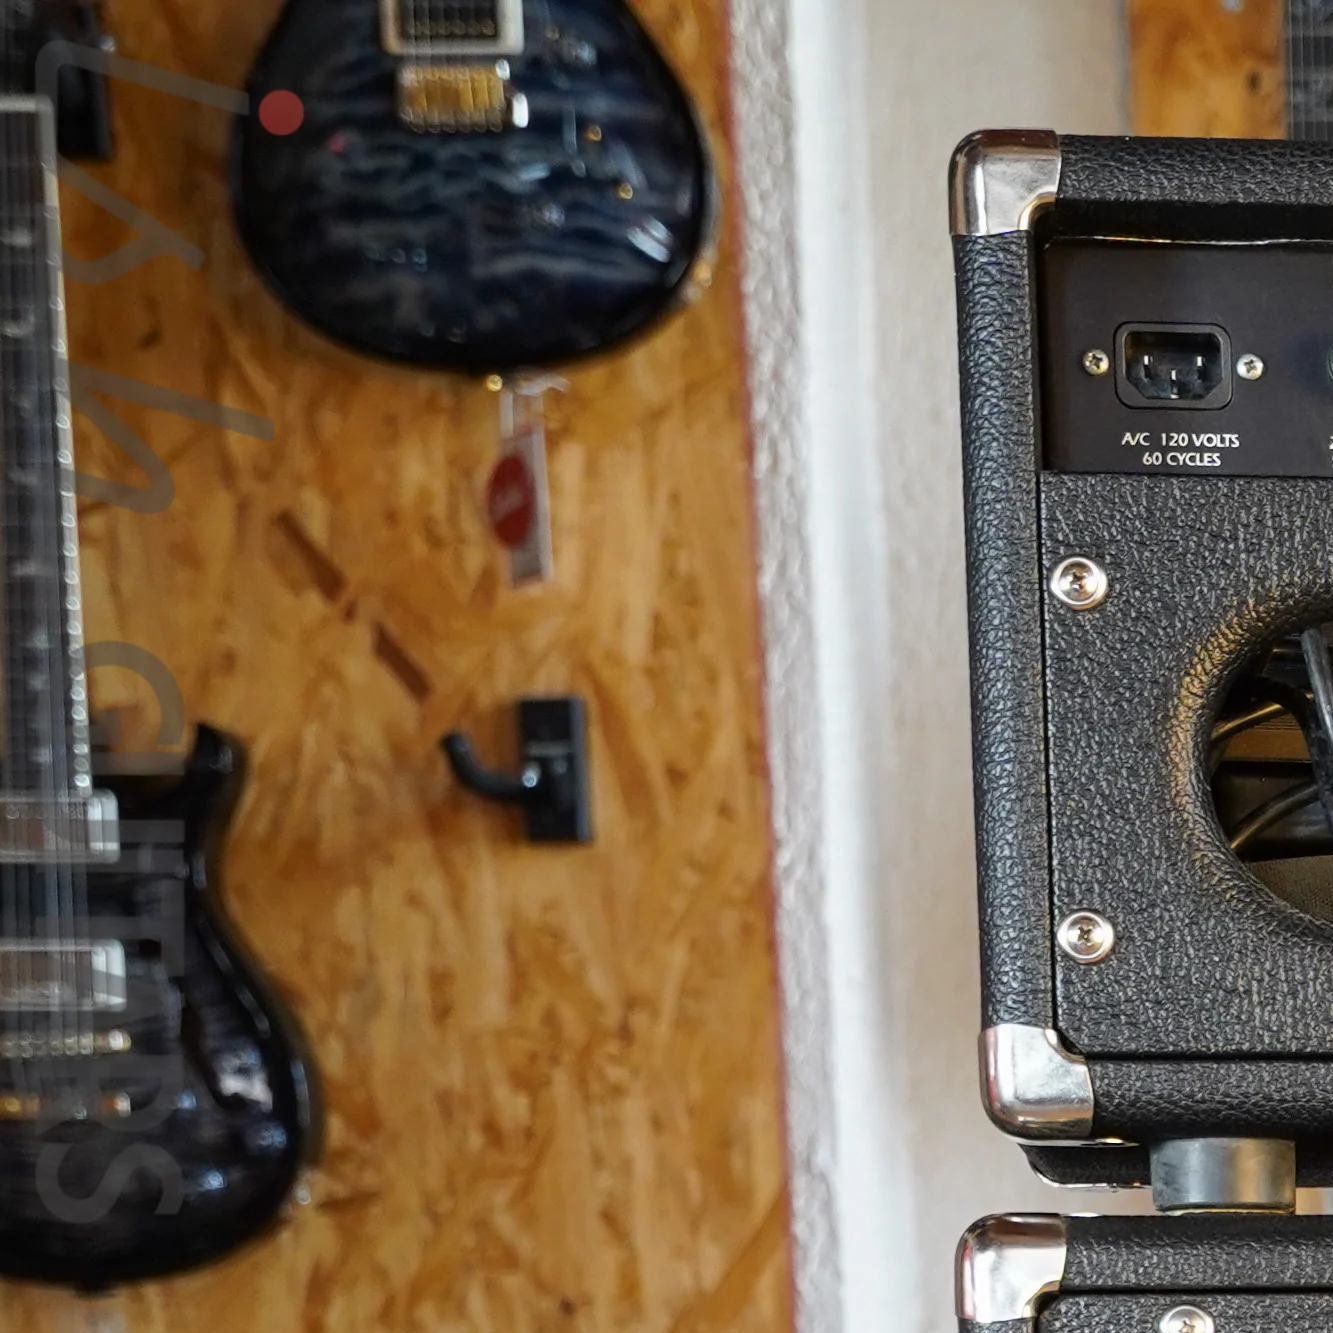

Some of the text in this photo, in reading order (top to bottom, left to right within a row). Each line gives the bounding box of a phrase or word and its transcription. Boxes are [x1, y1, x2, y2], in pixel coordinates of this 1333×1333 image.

[1121, 432, 1240, 448] A/C 120 VOLTS
[1142, 451, 1222, 467] 60 CYCLES
